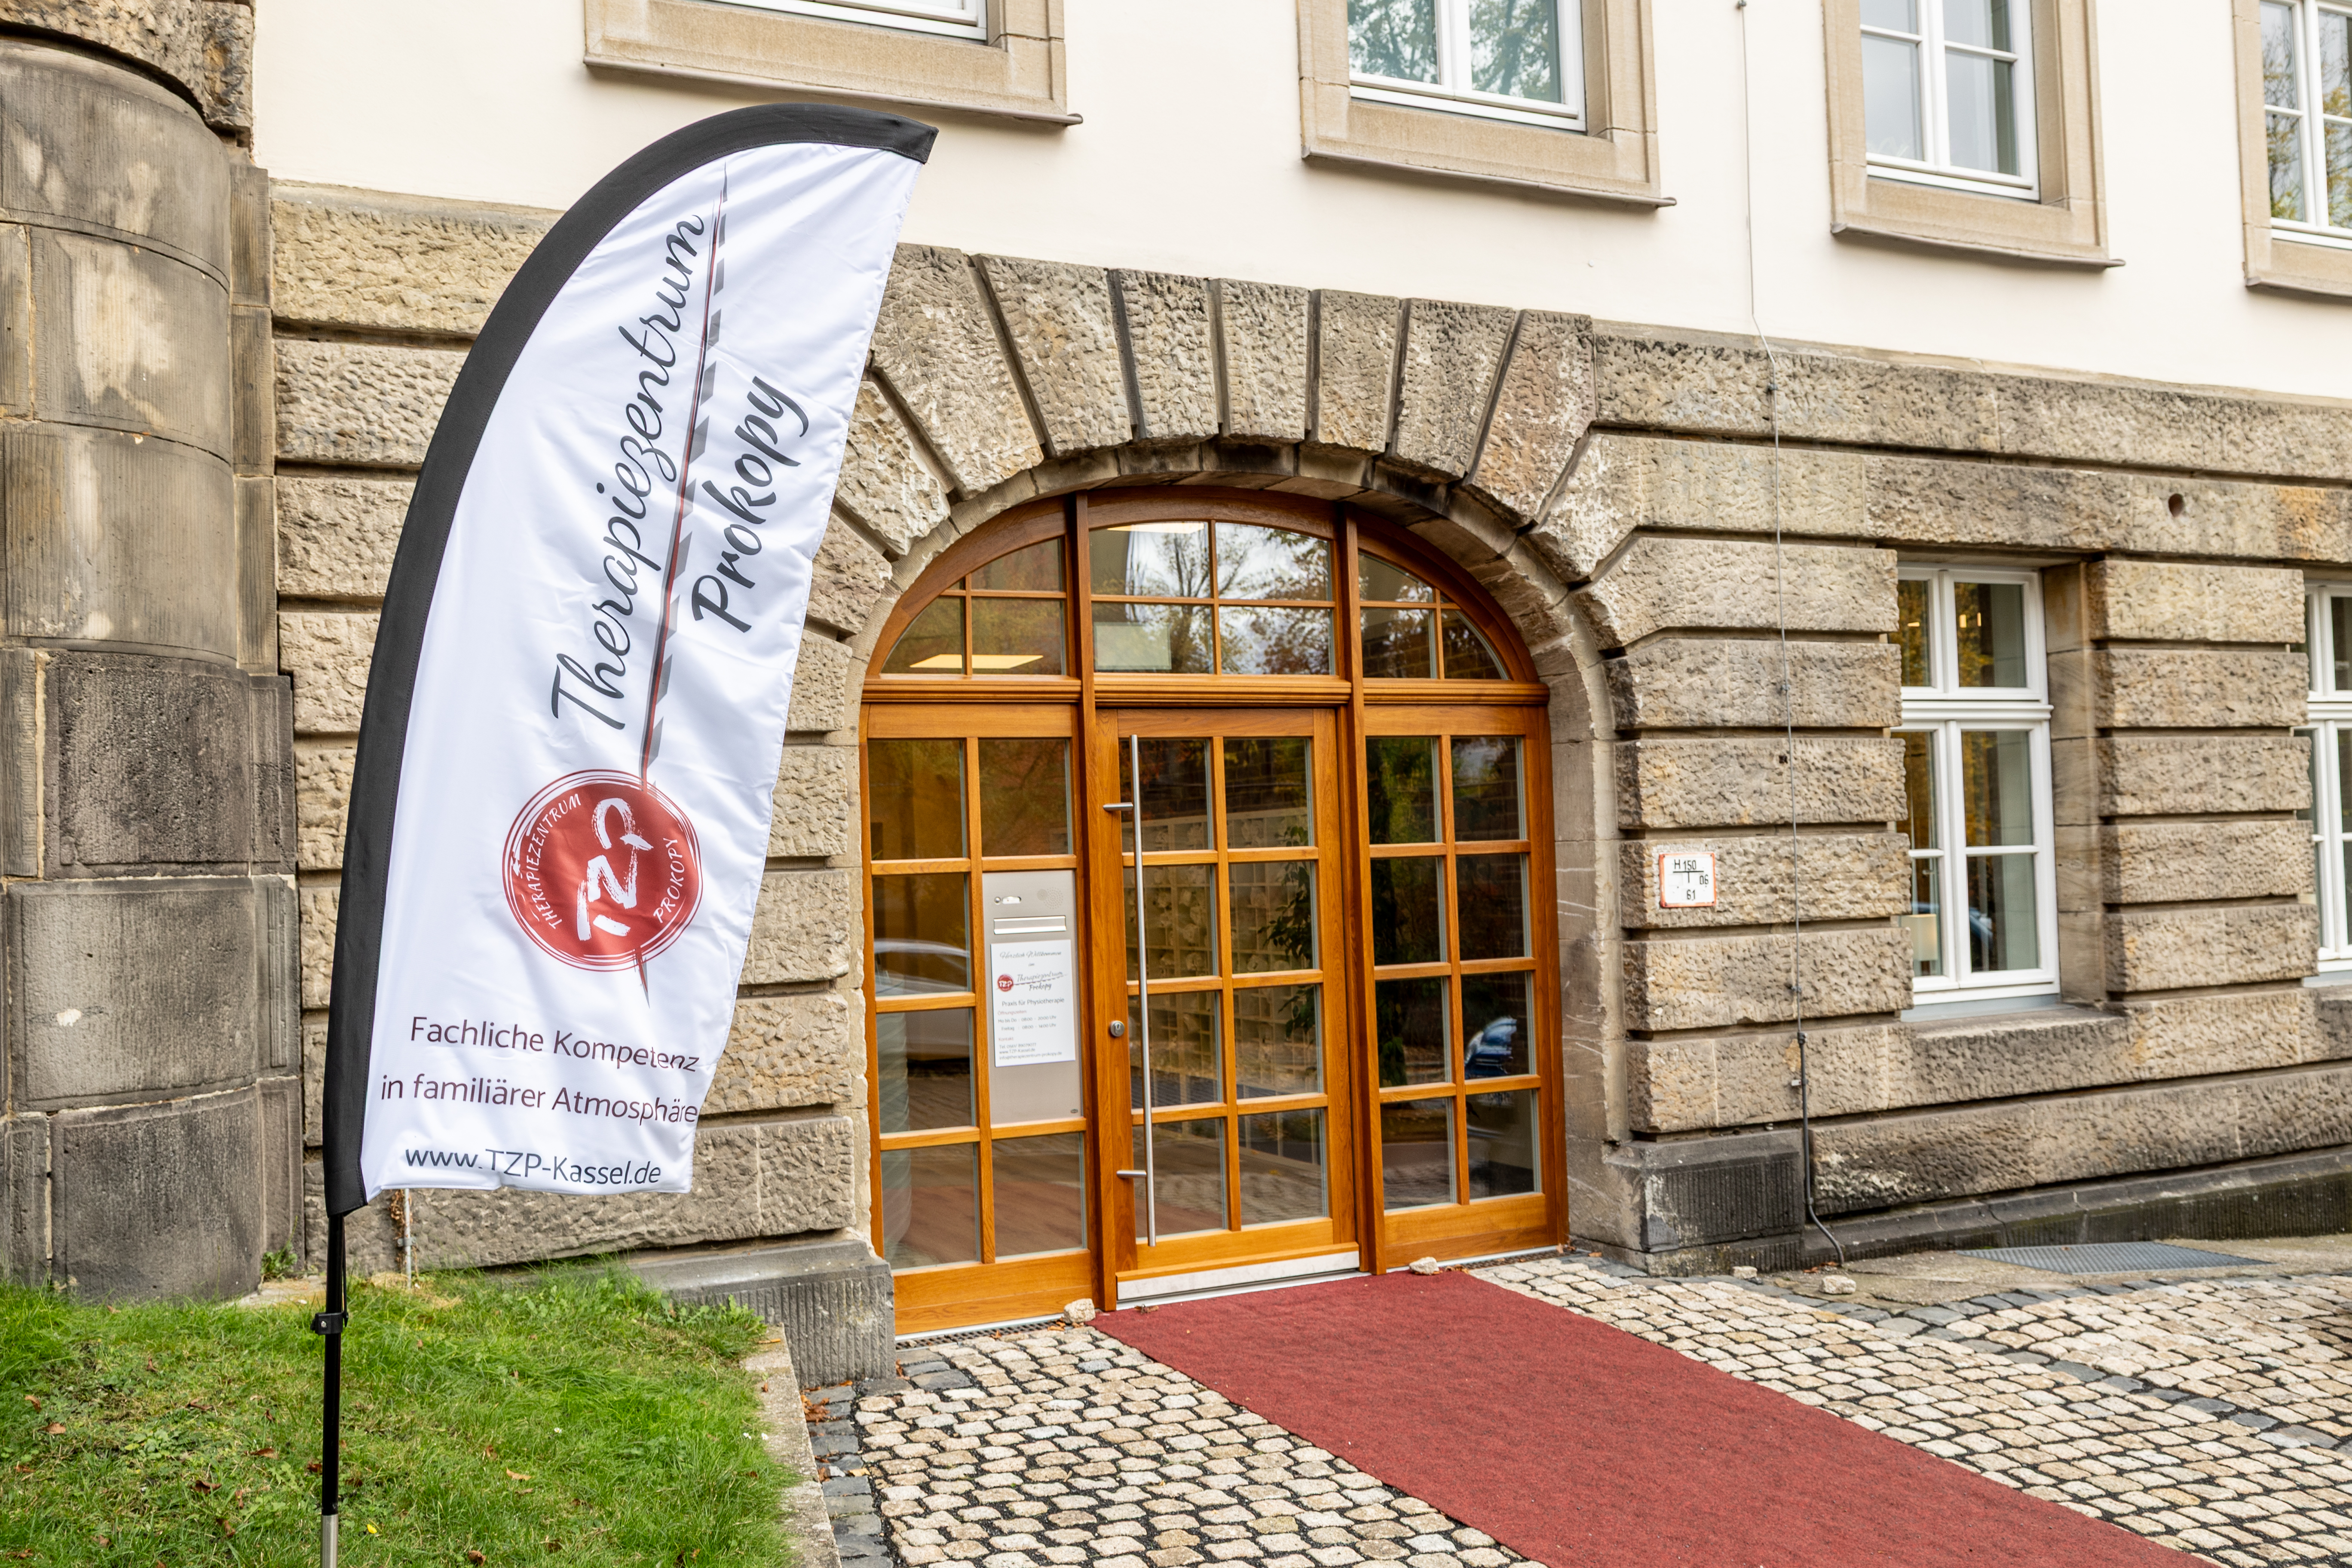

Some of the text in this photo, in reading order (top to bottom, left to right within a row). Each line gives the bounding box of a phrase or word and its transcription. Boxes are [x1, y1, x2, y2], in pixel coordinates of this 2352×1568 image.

[551, 214, 705, 731] Therapiezentrum
[691, 375, 810, 633] Prokopy
[526, 793, 582, 930] THERAPIEZENTRUM
[1699, 874, 1709, 885] 06
[653, 837, 686, 924] PROKOPY
[1686, 889, 1696, 900] 61
[1026, 950, 1062, 959] Willkommen
[1017, 971, 1063, 983] Therapiezentrum
[1029, 982, 1052, 991] Prokopy
[1027, 997, 1065, 1006] Physiotherapie
[410, 1016, 699, 1072] Fachliche Kompetenz
[381, 1073, 698, 1126] in familiärer Atmosphäre
[405, 1148, 661, 1184] www.TZP-Kassel.de
